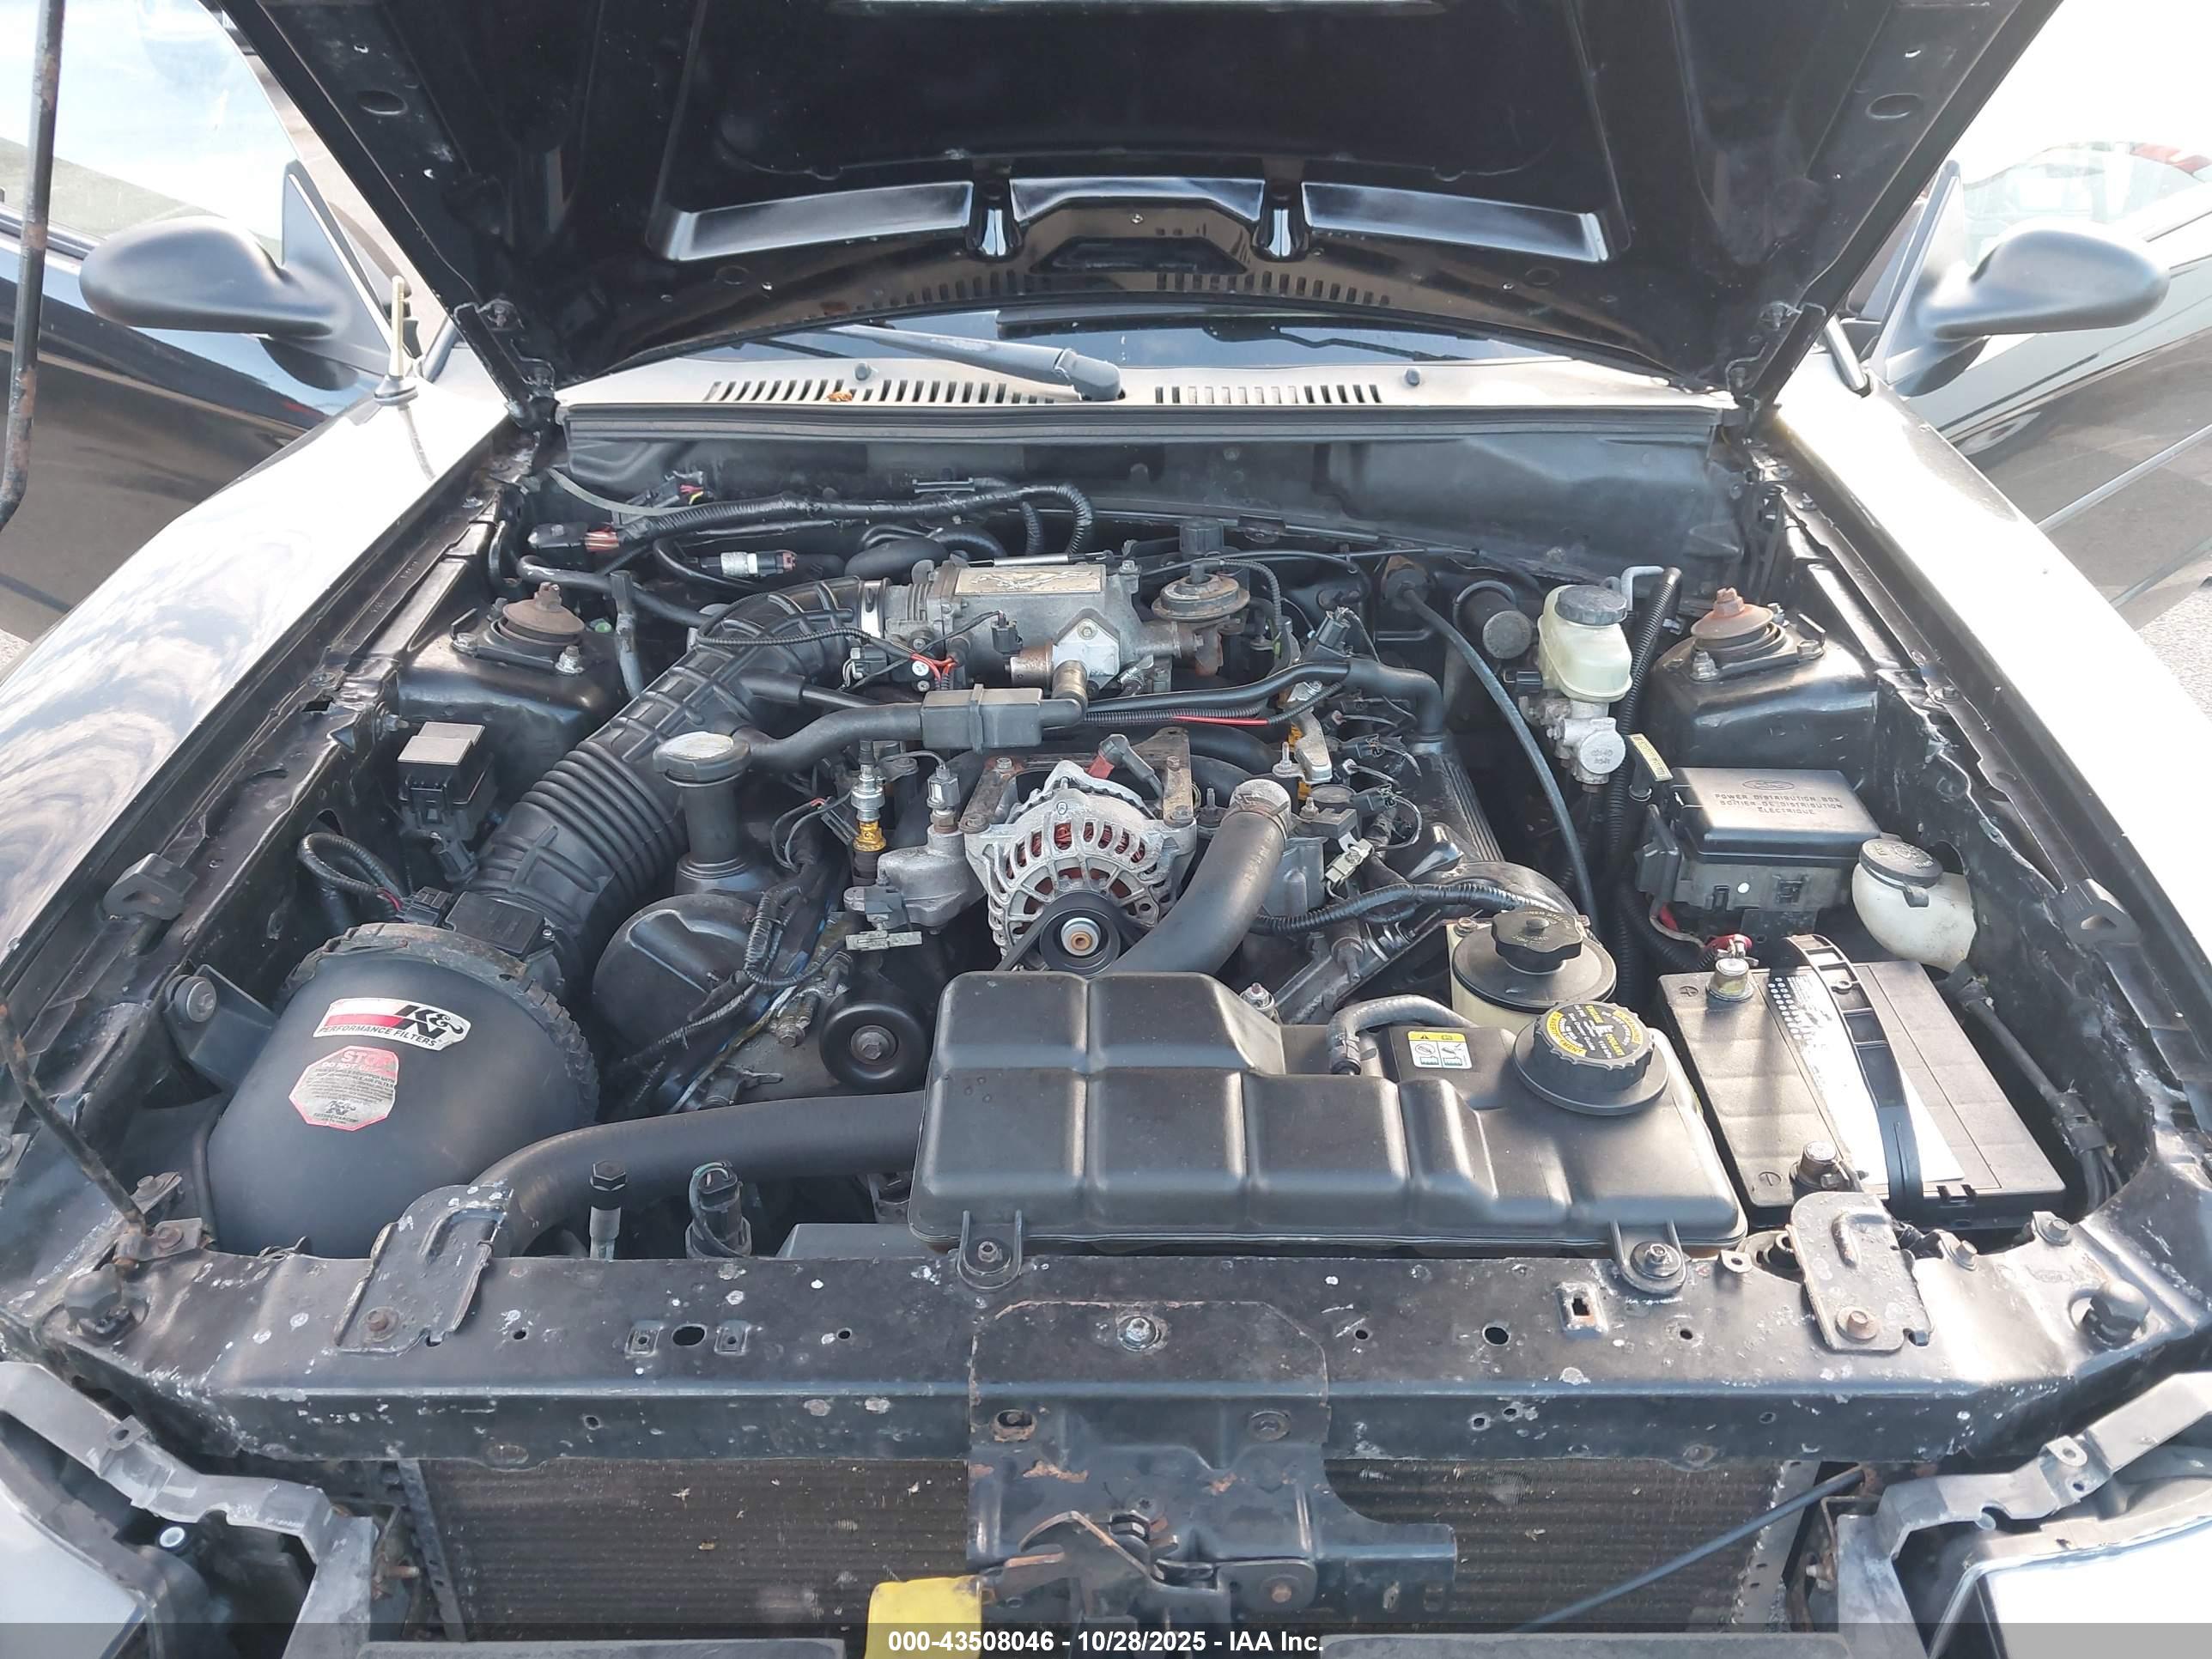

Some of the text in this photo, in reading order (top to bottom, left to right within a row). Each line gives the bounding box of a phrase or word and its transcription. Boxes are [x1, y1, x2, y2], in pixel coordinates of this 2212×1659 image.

[317, 1025, 437, 1047] PERFORMANCE FILTERS
[393, 1005, 464, 1040] K&N
[1585, 1005, 1626, 1056] ENGINE COOLANT
